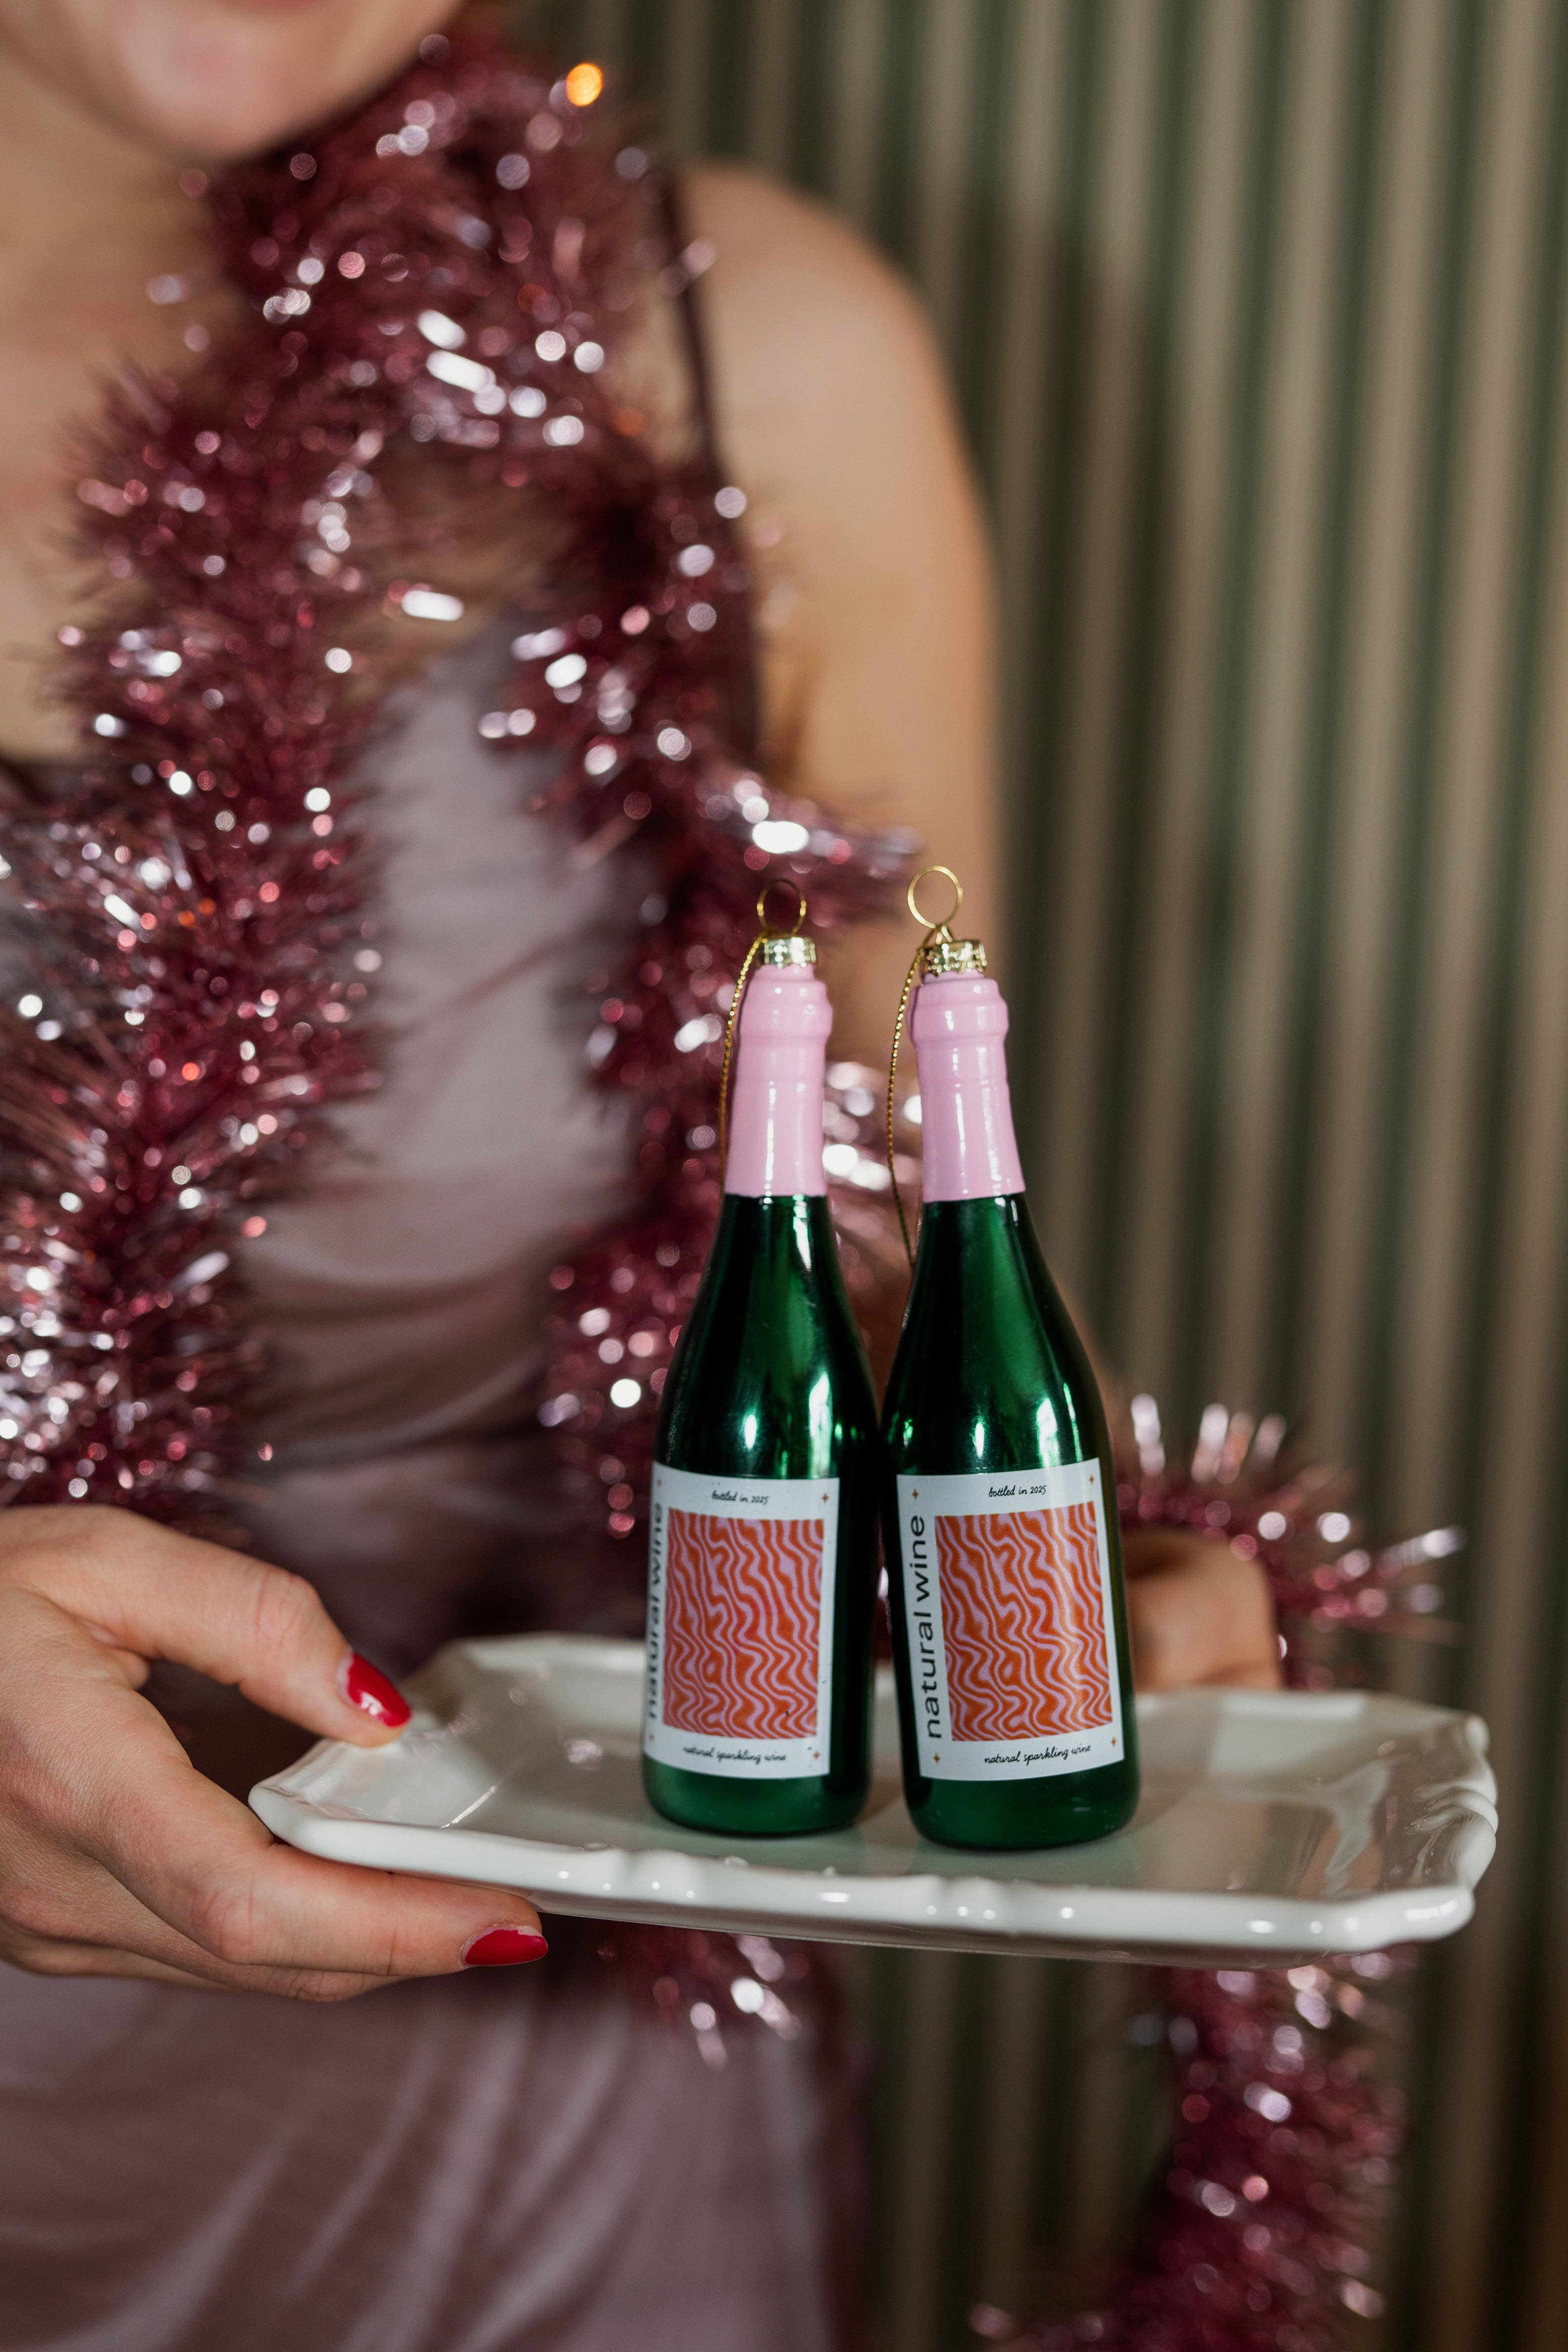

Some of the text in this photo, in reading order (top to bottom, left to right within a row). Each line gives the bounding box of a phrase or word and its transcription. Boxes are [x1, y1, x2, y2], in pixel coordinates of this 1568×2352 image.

[712, 1490, 769, 1505] bottled in 2025
[988, 1485, 1046, 1497] bottled in 2025
[648, 1502, 663, 1719] natural wine
[910, 1515, 941, 1738] natural wine
[683, 1746, 786, 1765] natural sparkling wine
[984, 1743, 1091, 1765] natural sparkling wine
